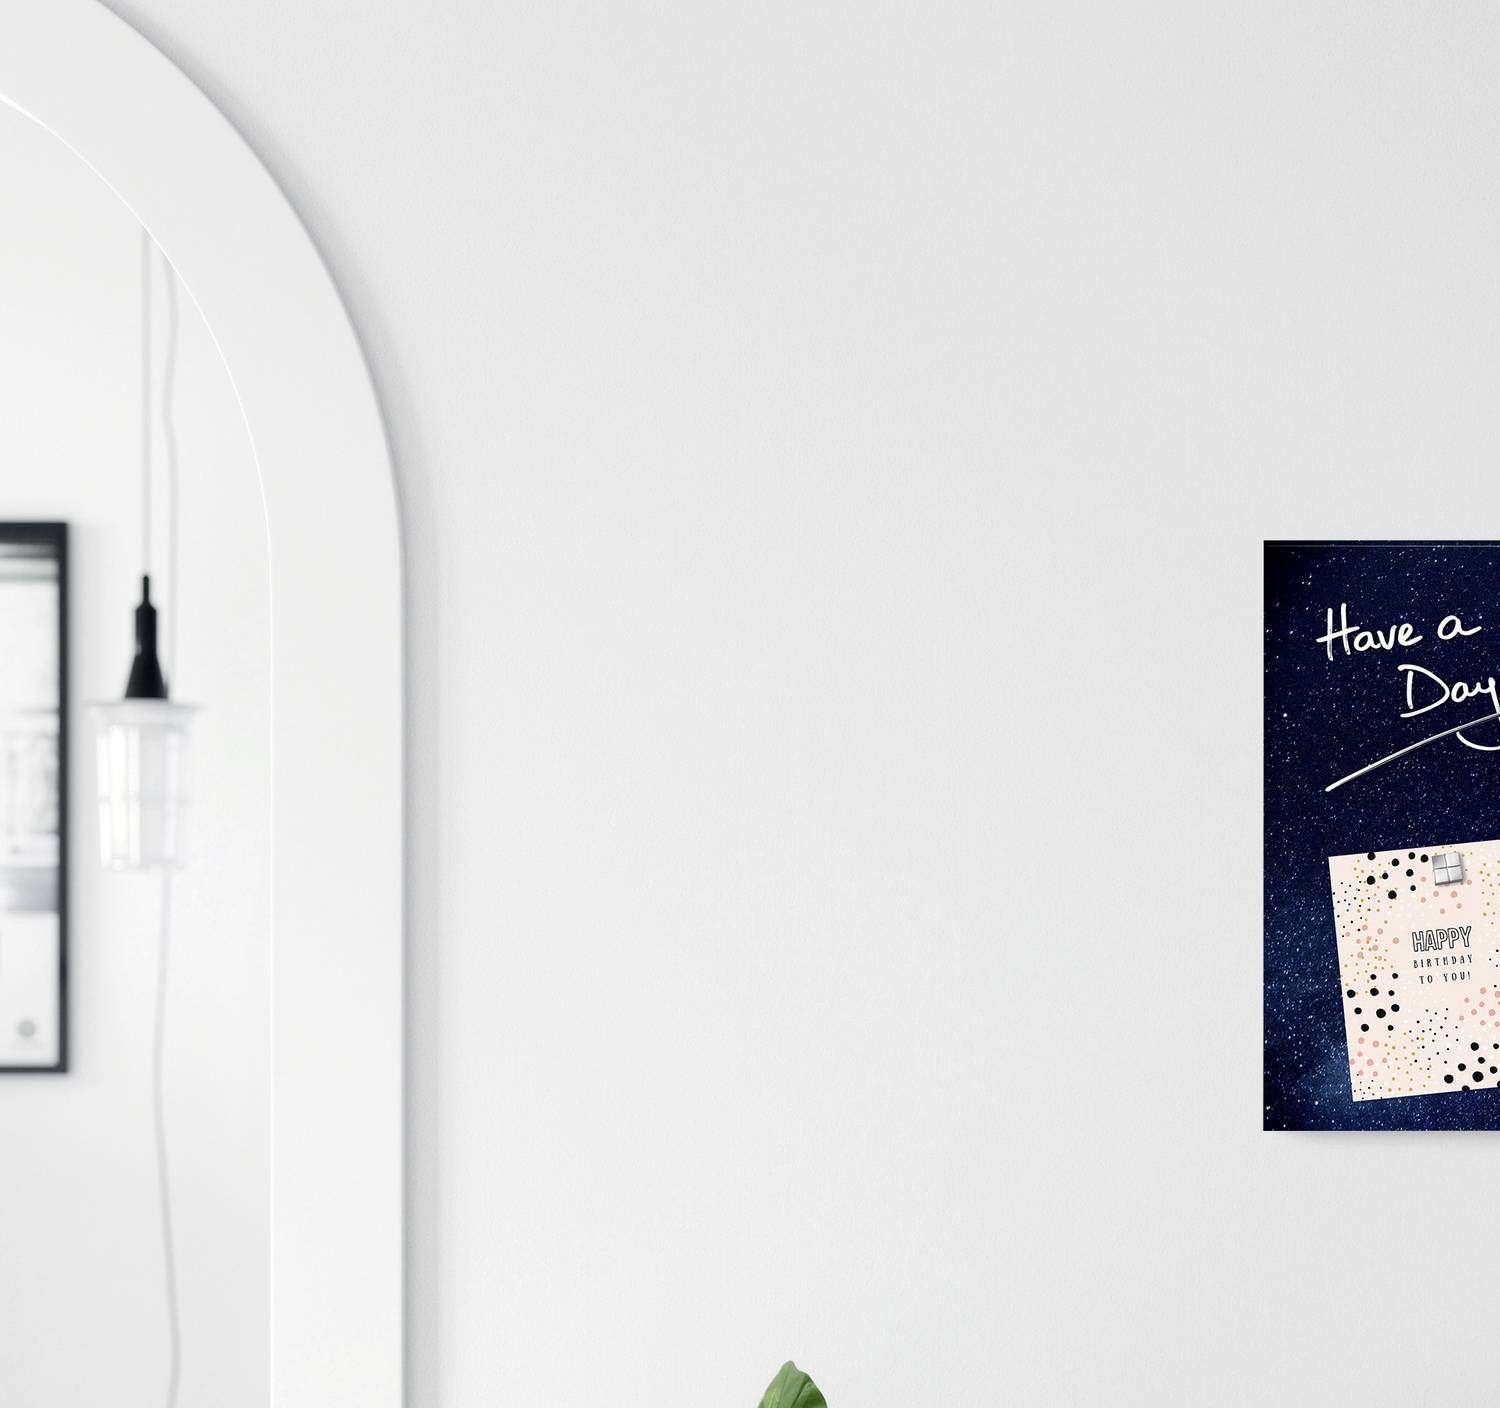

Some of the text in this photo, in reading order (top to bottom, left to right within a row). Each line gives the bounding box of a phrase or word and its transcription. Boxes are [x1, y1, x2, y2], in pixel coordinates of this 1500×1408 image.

[1316, 602, 1423, 662] Have
[1436, 614, 1482, 641] a
[1411, 925, 1472, 952] HAPPY
[1413, 954, 1473, 969] BIRTHDAY
[1419, 971, 1471, 985] TO YOU!
